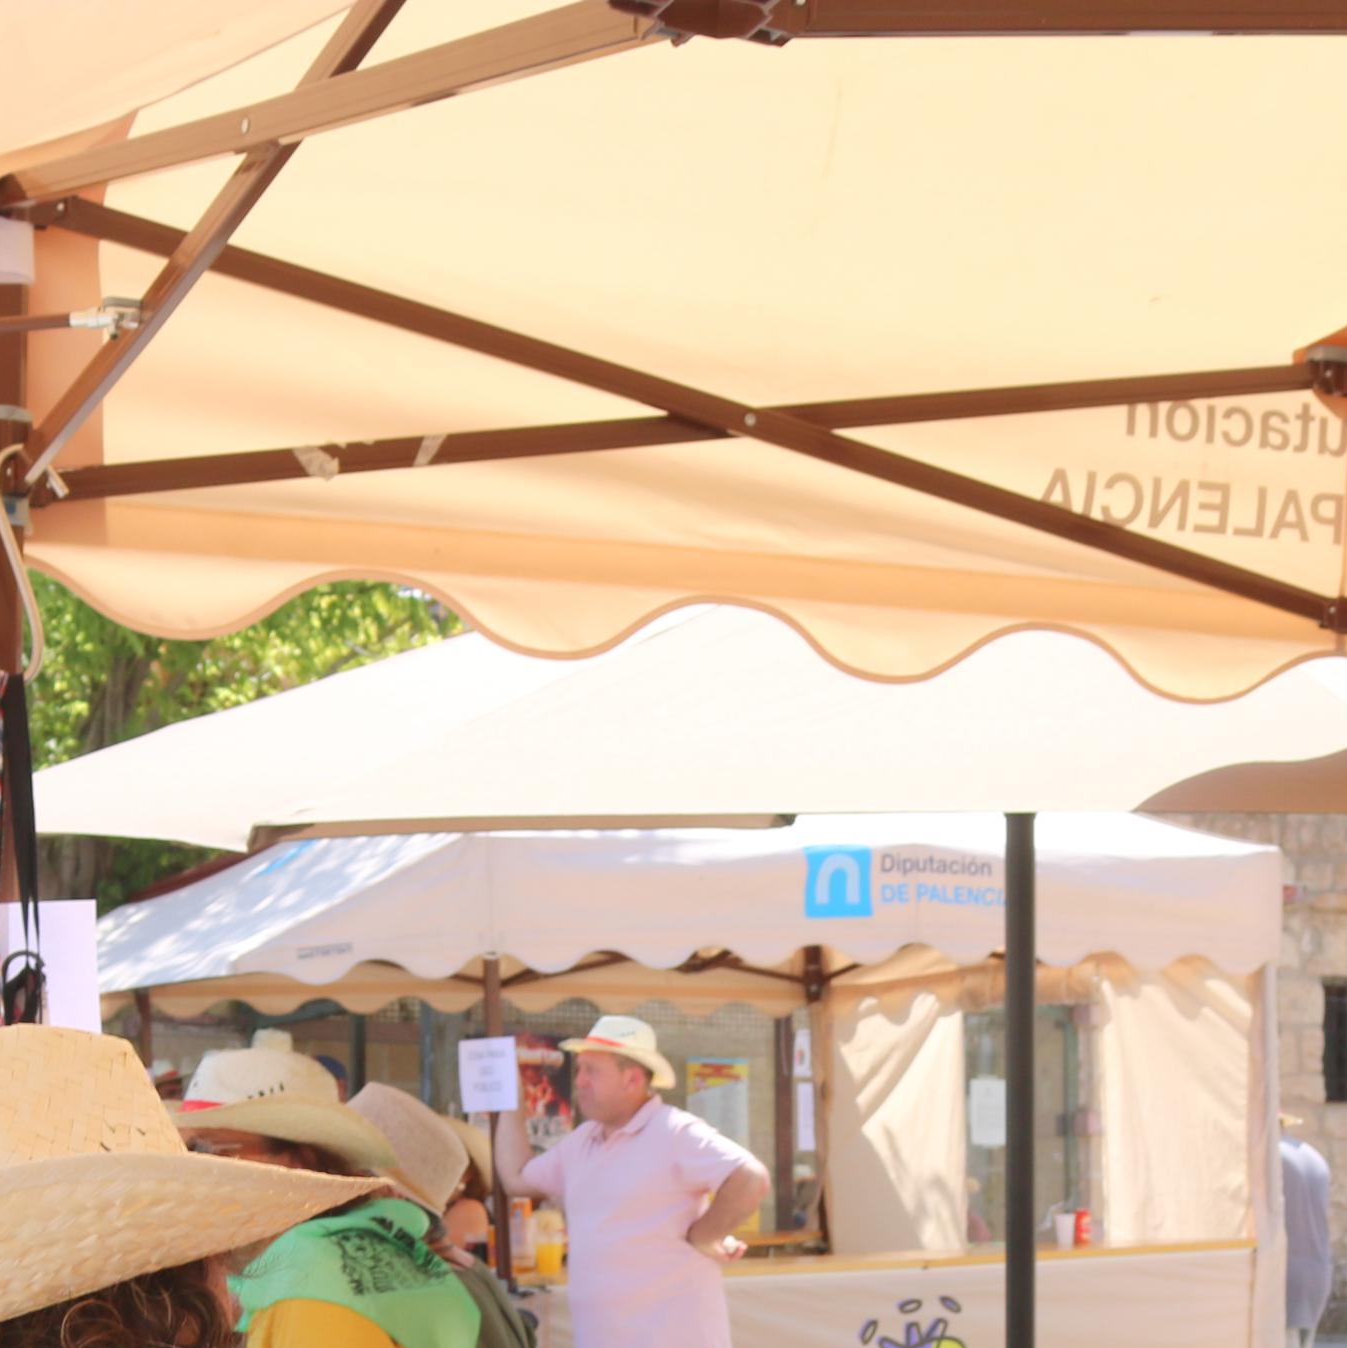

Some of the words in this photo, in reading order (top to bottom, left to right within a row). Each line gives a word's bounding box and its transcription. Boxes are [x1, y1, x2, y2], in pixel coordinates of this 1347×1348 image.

[880, 852, 992, 878] Diputación
[880, 883, 909, 903] DE
[915, 883, 1005, 907] PALENCI
